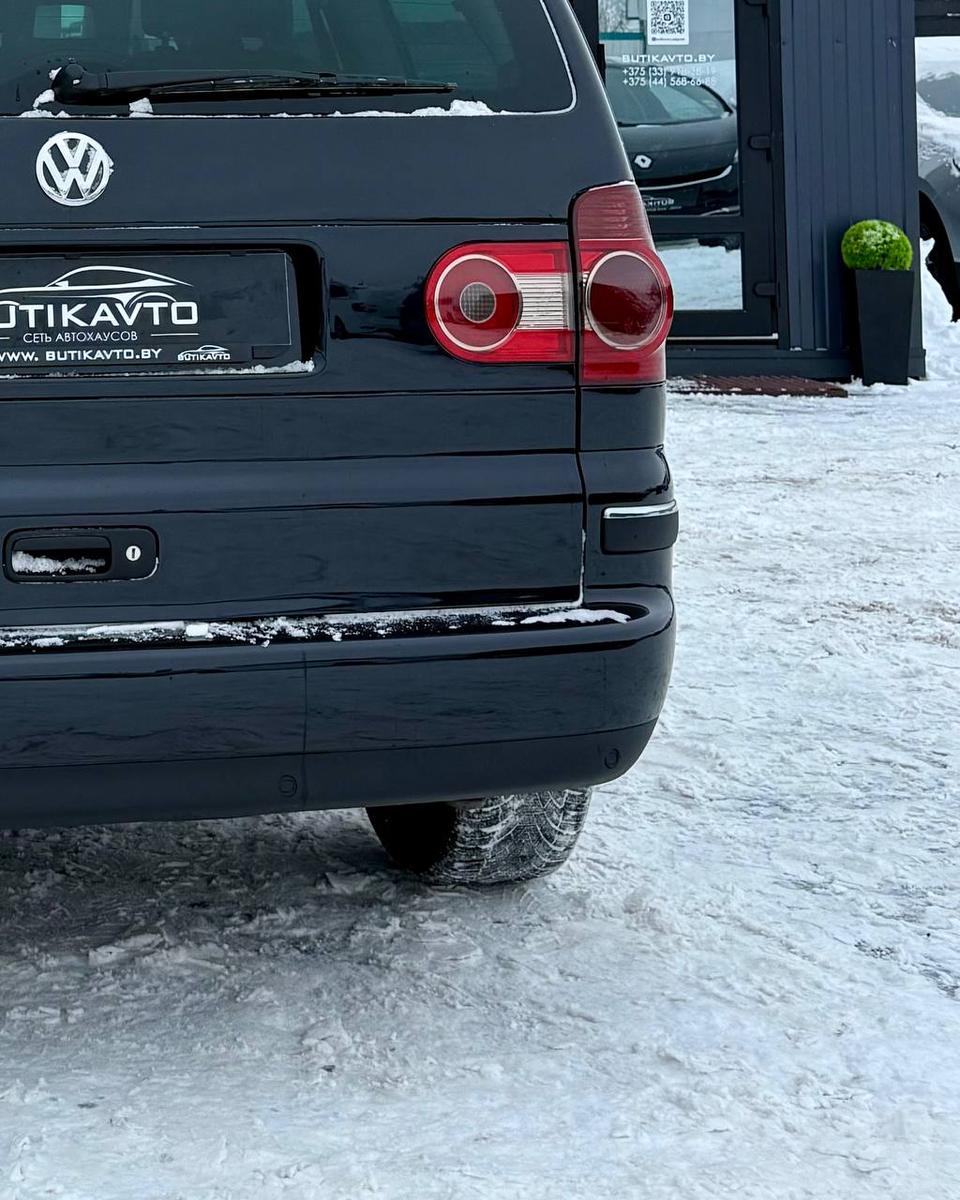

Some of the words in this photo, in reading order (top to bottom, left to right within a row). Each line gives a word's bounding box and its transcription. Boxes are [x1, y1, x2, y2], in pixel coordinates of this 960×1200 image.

[622, 54, 716, 63] BUTIKAVTO.BY
[622, 67, 646, 76] +375
[622, 77, 646, 87] +375
[648, 77, 667, 88] (44)
[23, 333, 52, 343] СЕТЬ
[55, 331, 138, 343] АВТОХАУСОВ
[45, 348, 162, 361] BUTIKAVTO.BY
[177, 353, 231, 361] BUTIKAVTO
